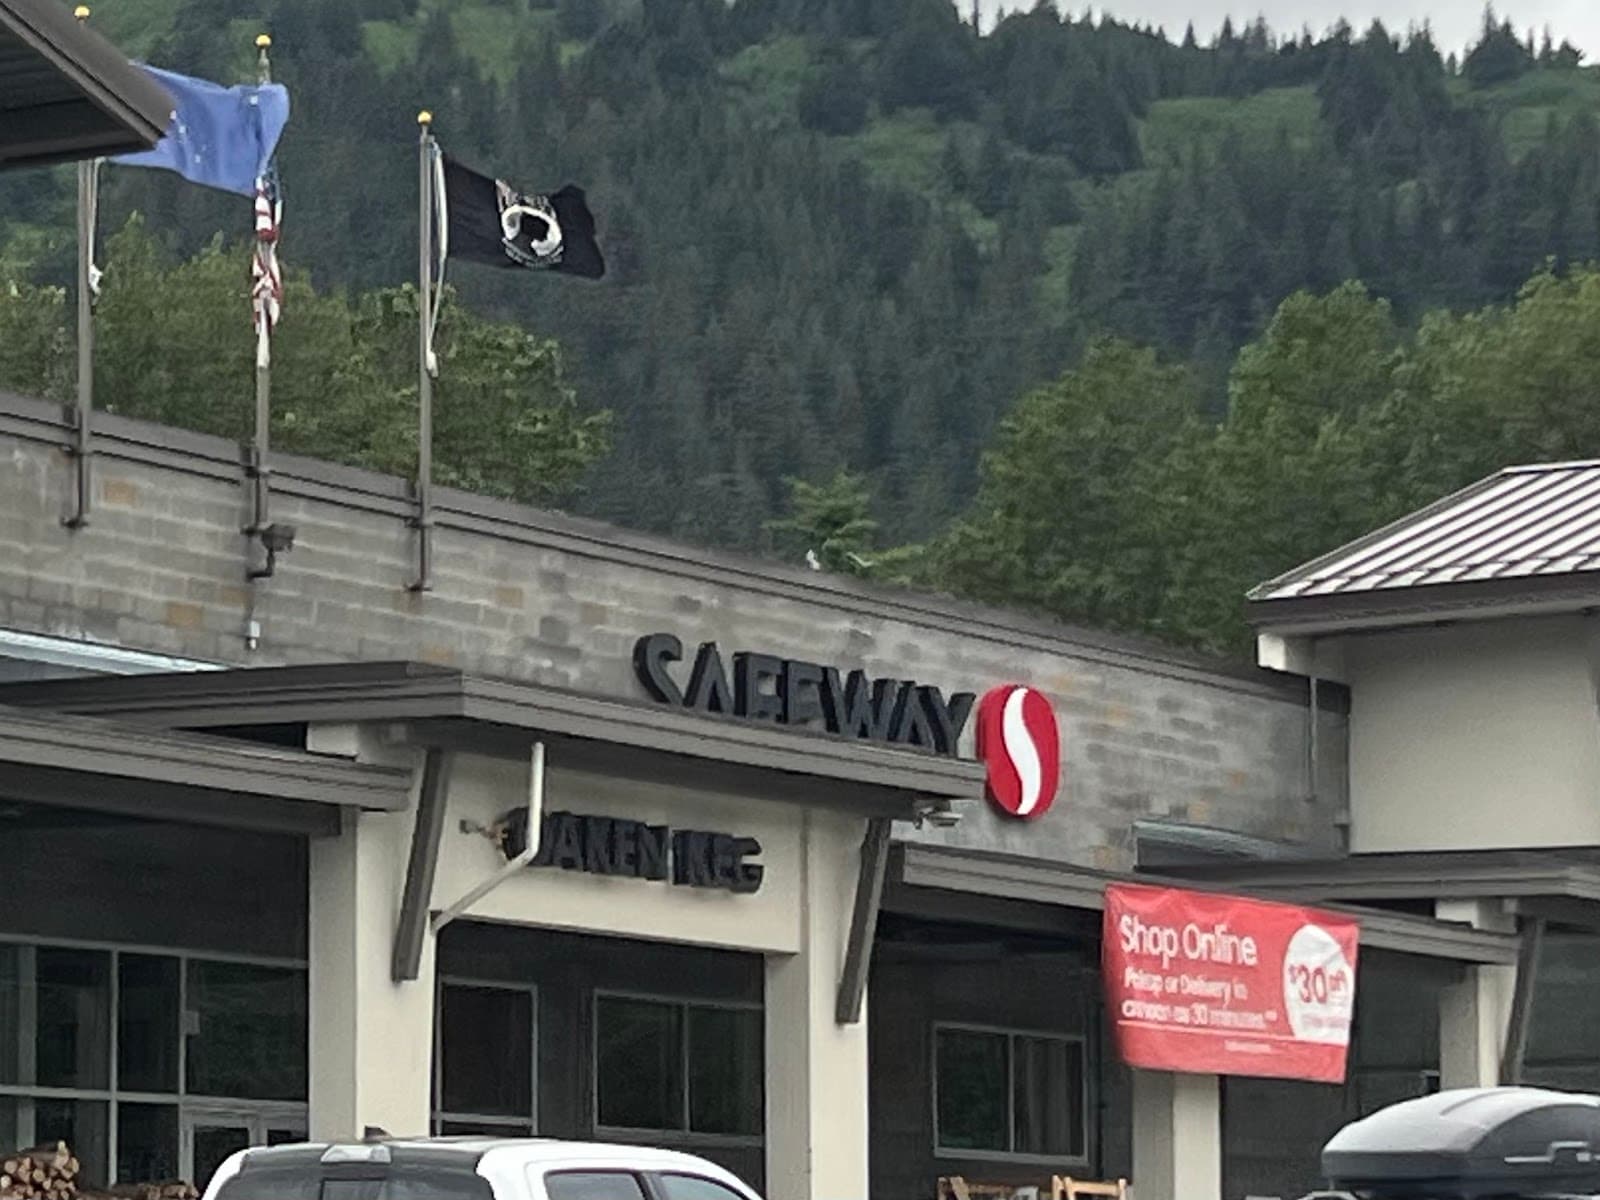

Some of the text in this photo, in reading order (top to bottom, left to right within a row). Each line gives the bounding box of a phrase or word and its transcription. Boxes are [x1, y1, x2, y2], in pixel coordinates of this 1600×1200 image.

[633, 633, 976, 757] SAFEWAY
[671, 829, 765, 893] KEG
[1119, 914, 1258, 969] Shop Online
